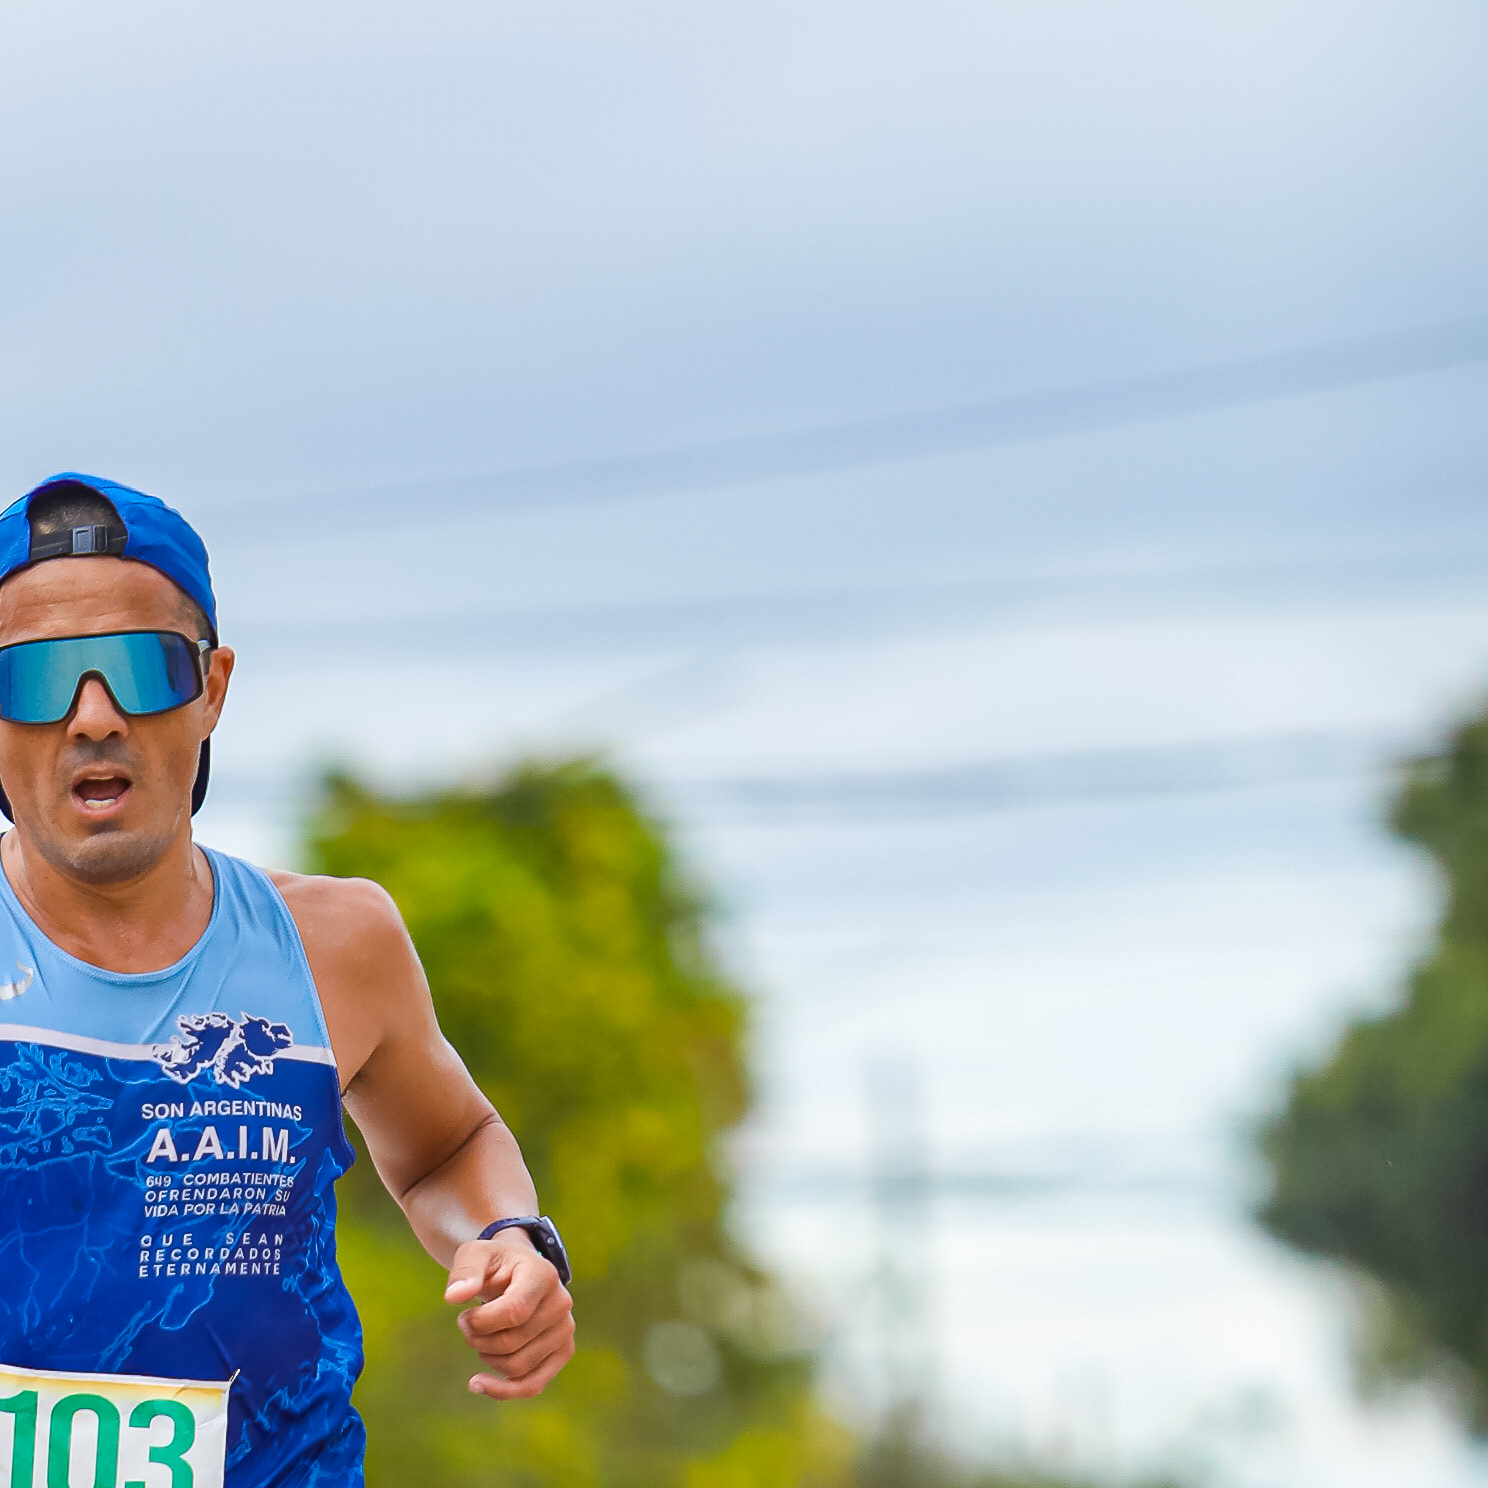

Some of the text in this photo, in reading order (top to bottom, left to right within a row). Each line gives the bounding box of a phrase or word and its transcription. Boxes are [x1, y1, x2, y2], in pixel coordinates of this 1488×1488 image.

[141, 1100, 302, 1121] SON ARGENTINAS
[146, 1125, 296, 1164] A.A.I.M.
[145, 1172, 295, 1188] 649 COMBATIENTES
[144, 1188, 291, 1203] OFRENDARON SU
[144, 1202, 287, 1218] VIDA POR LA PATRIA
[140, 1232, 283, 1247] QUE SEAN
[139, 1247, 281, 1263] RECORDADOS
[138, 1262, 280, 1278] ETERNAMENTE
